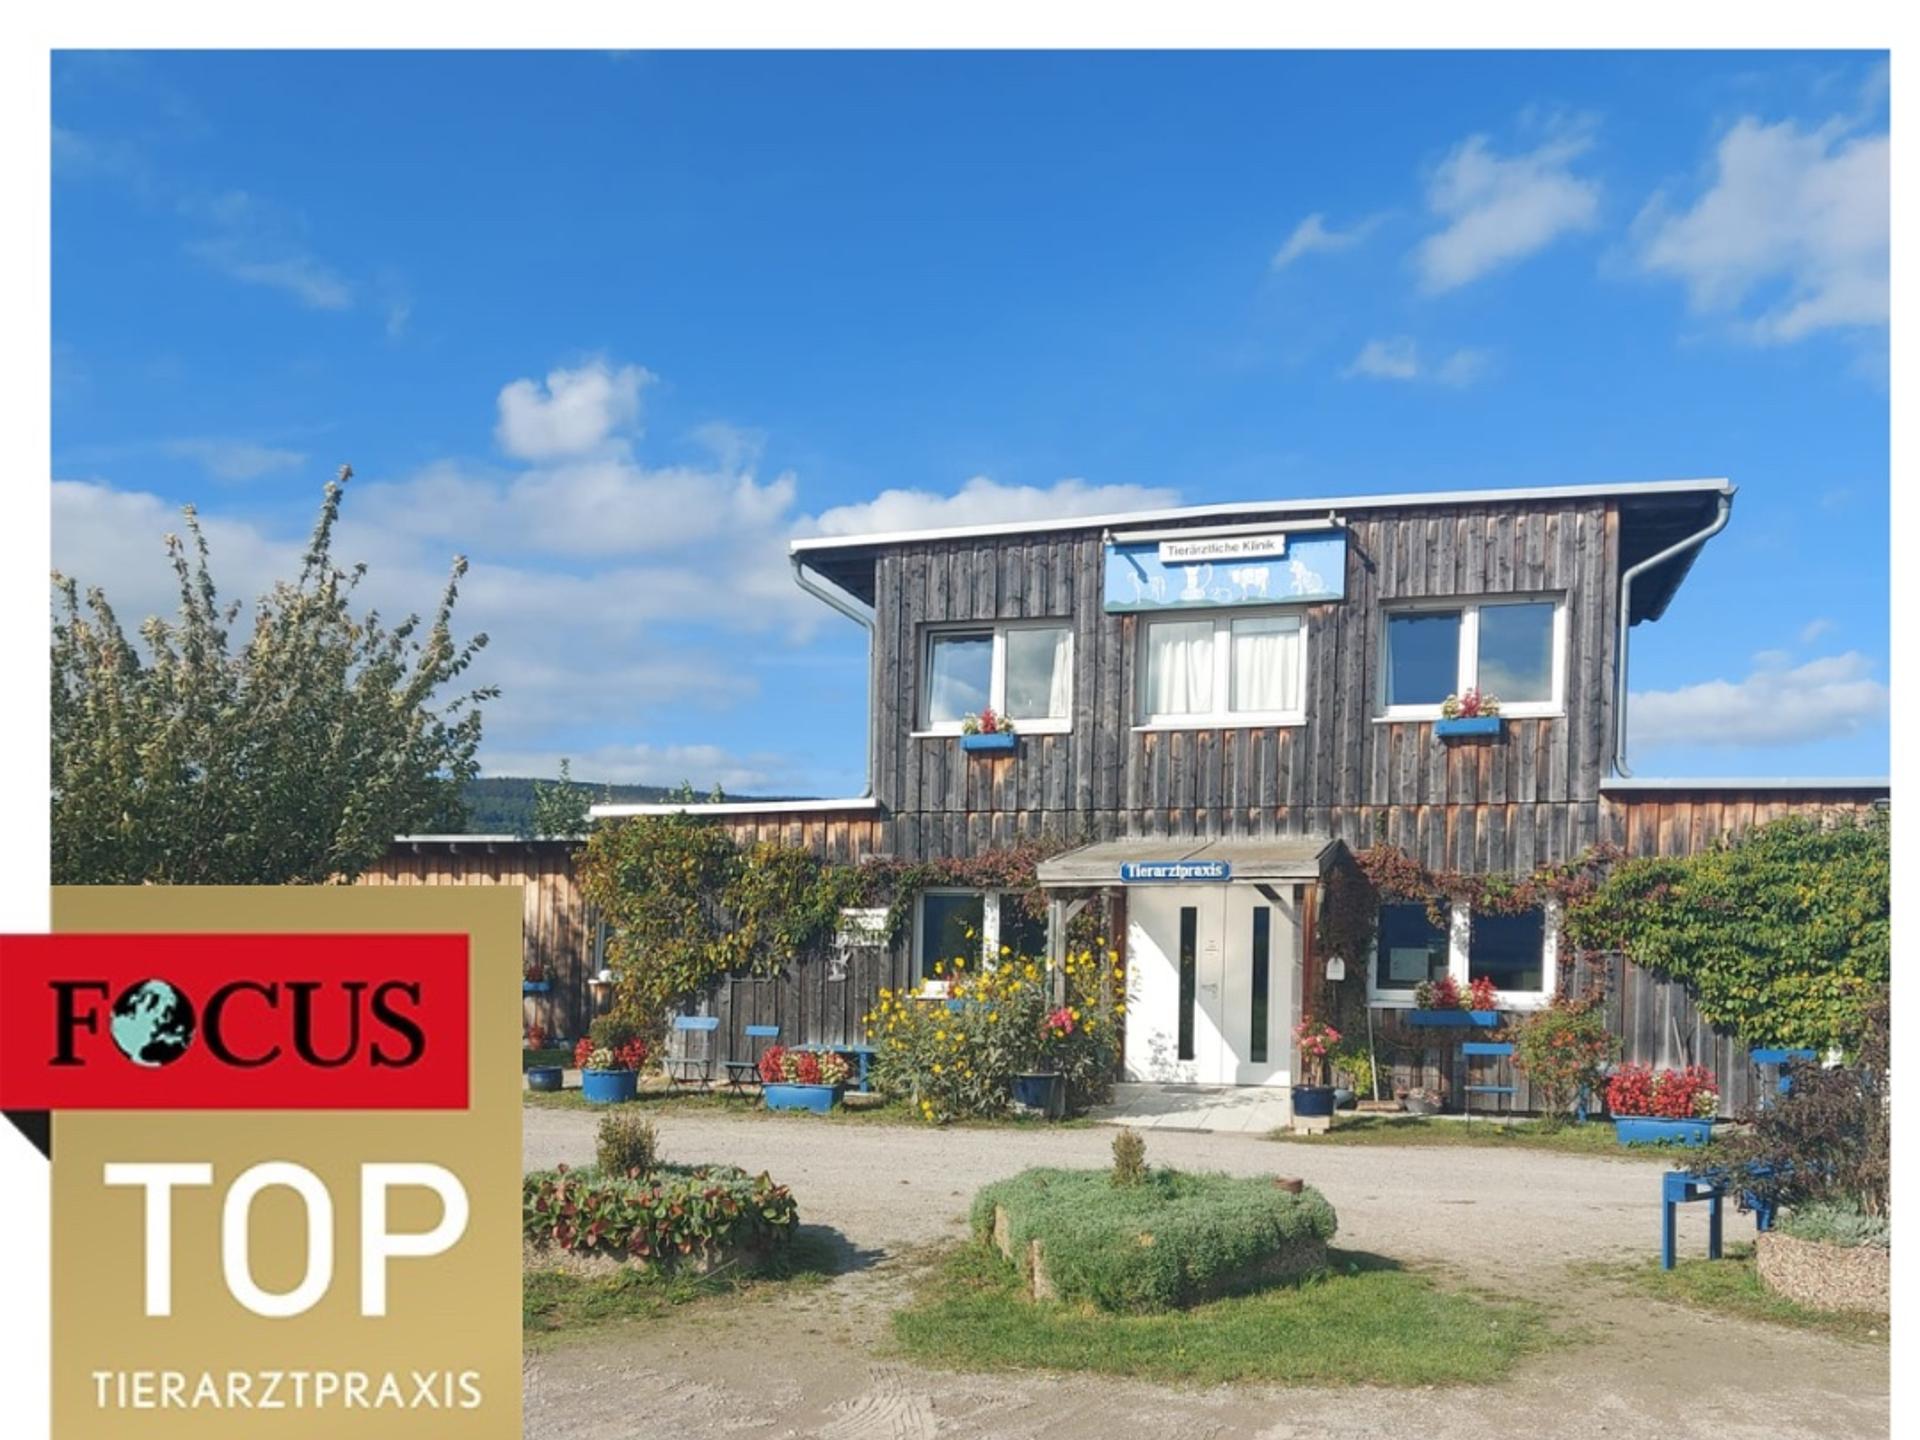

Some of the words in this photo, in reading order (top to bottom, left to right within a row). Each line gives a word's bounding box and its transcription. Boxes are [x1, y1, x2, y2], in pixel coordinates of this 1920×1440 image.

[1167, 542, 1240, 557] Tierärztliche
[1242, 539, 1275, 552] Klinik
[1129, 862, 1223, 880] Tierarztpraxis
